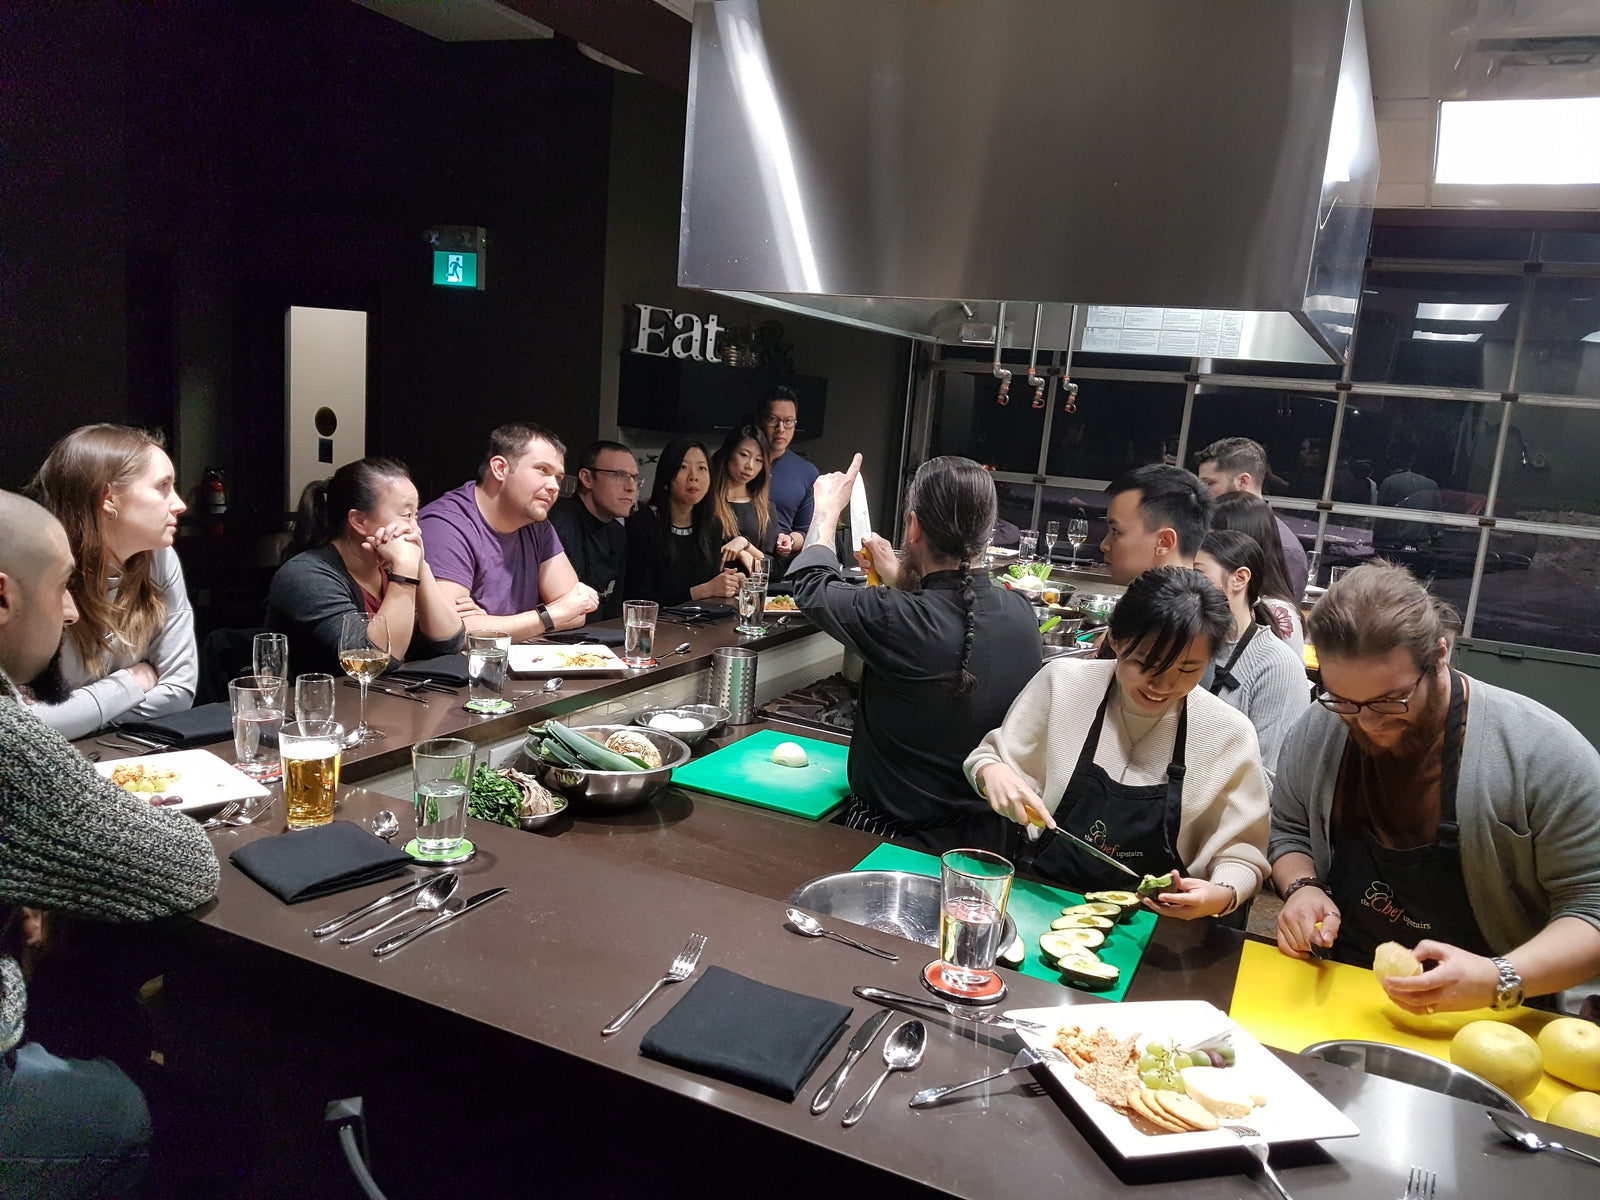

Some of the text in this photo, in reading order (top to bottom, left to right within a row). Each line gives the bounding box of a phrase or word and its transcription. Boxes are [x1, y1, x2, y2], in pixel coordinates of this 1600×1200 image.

[630, 303, 725, 364] Eat
[1094, 834, 1121, 858] Chef
[1116, 850, 1144, 859] upstairs
[1370, 897, 1405, 923] Chef
[1403, 915, 1432, 930] upstairs
